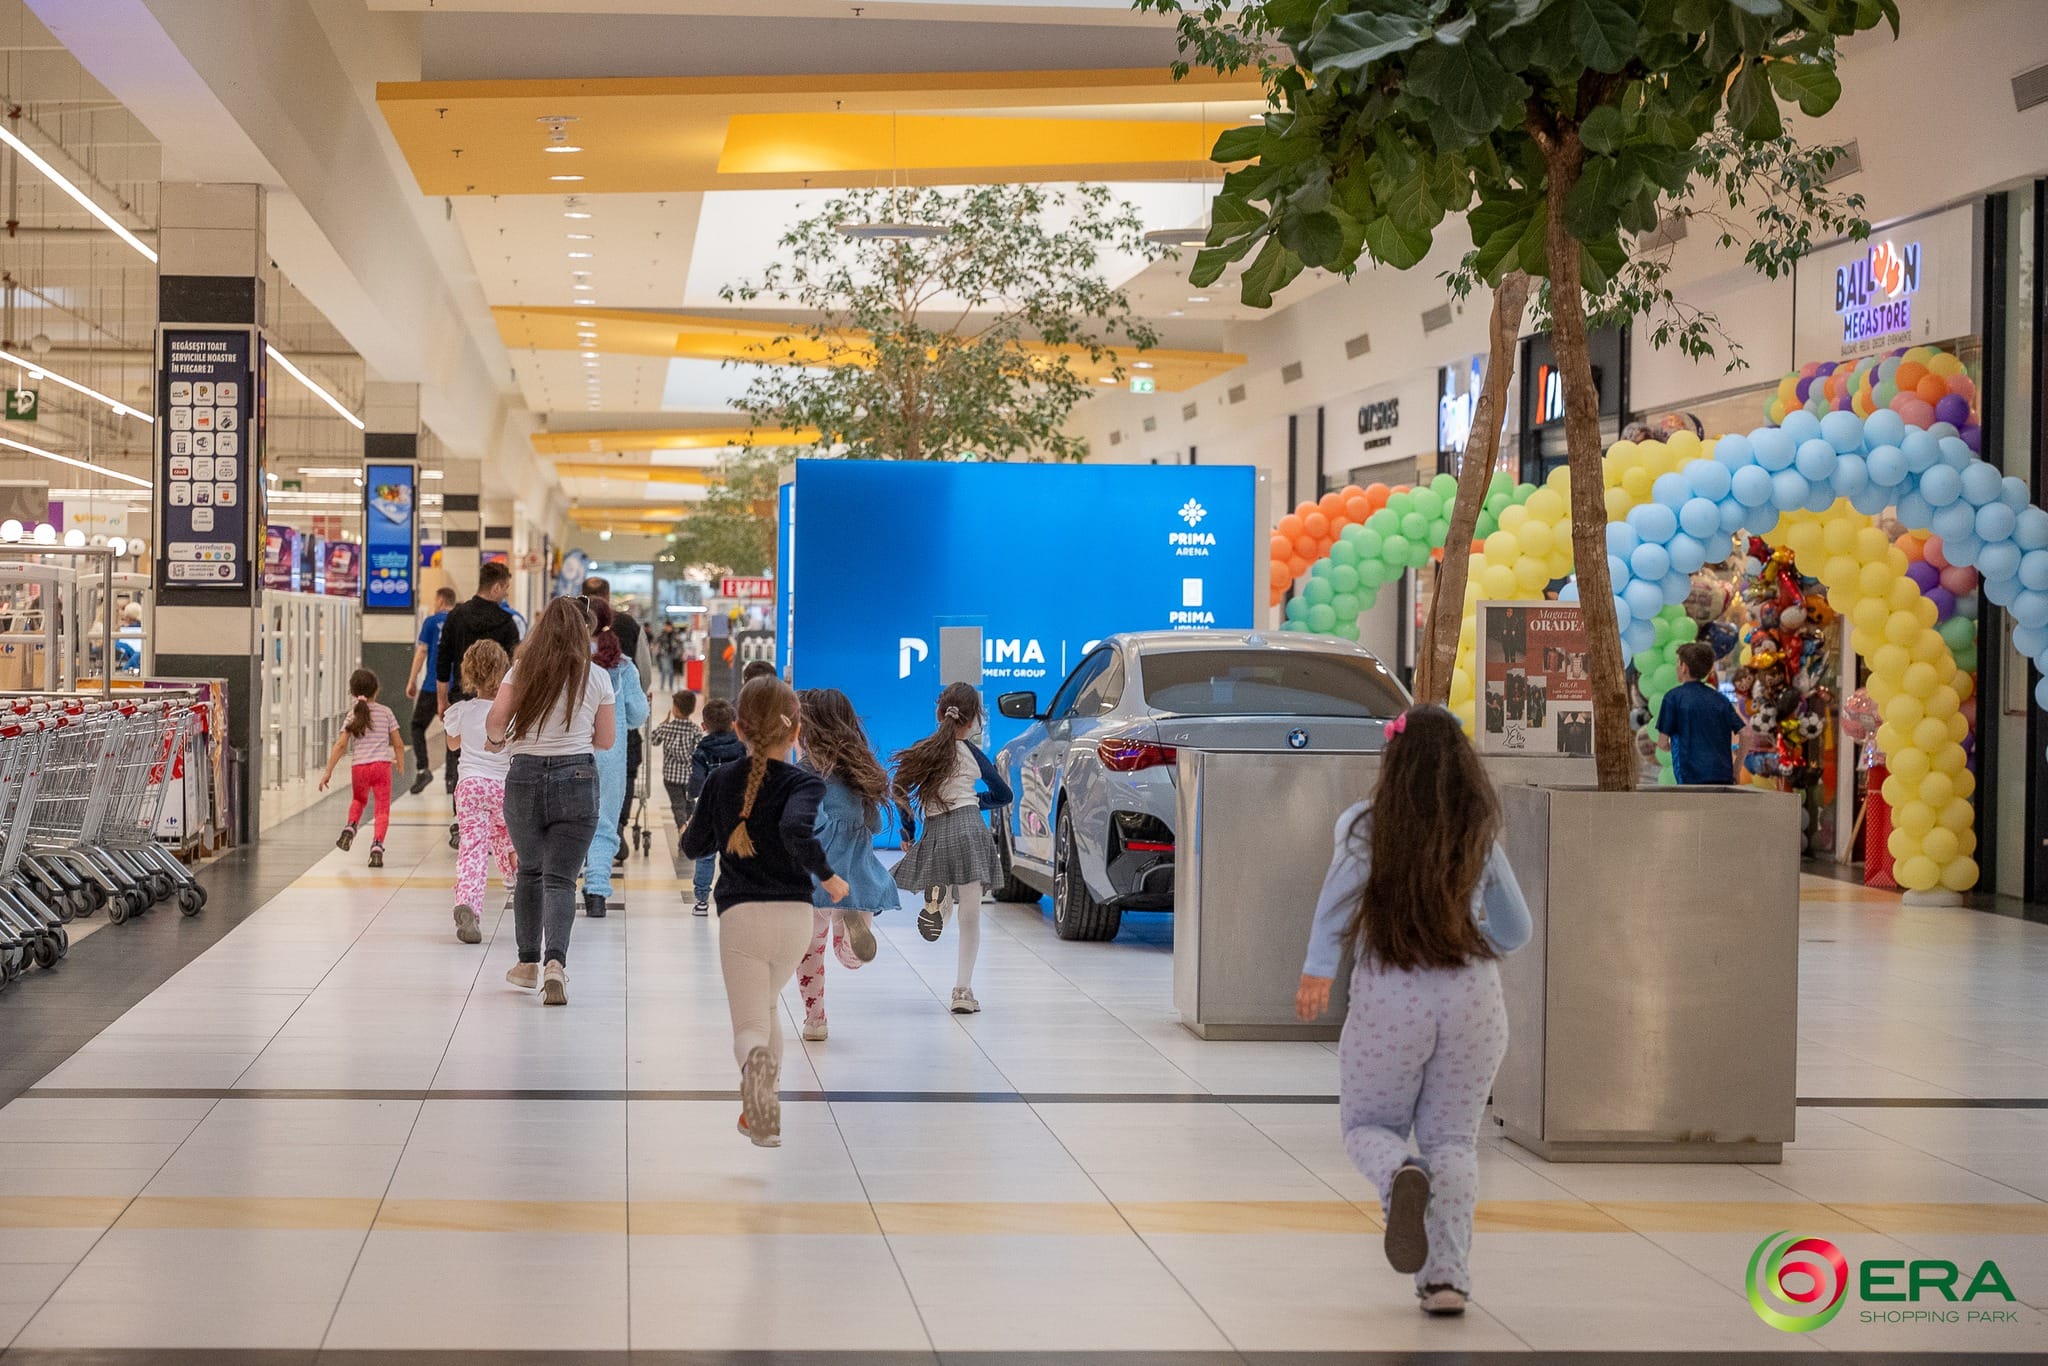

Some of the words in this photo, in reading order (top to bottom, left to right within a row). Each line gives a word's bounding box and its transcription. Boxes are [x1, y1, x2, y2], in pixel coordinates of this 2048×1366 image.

[1844, 300, 1909, 341] MEGASTORE
[207, 342, 227, 351] TOATE
[171, 353, 206, 362] SERVICIILE
[207, 354, 237, 363] NOASTRE
[171, 363, 179, 373] ÎN
[180, 365, 206, 373] FIECARE
[207, 365, 214, 373] ZI
[1169, 533, 1216, 545] PRIMA
[1176, 547, 1209, 556] ARENA
[1169, 611, 1215, 624] PRIMA
[1539, 609, 1577, 621] Magazin
[1013, 668, 1046, 678] GROUP
